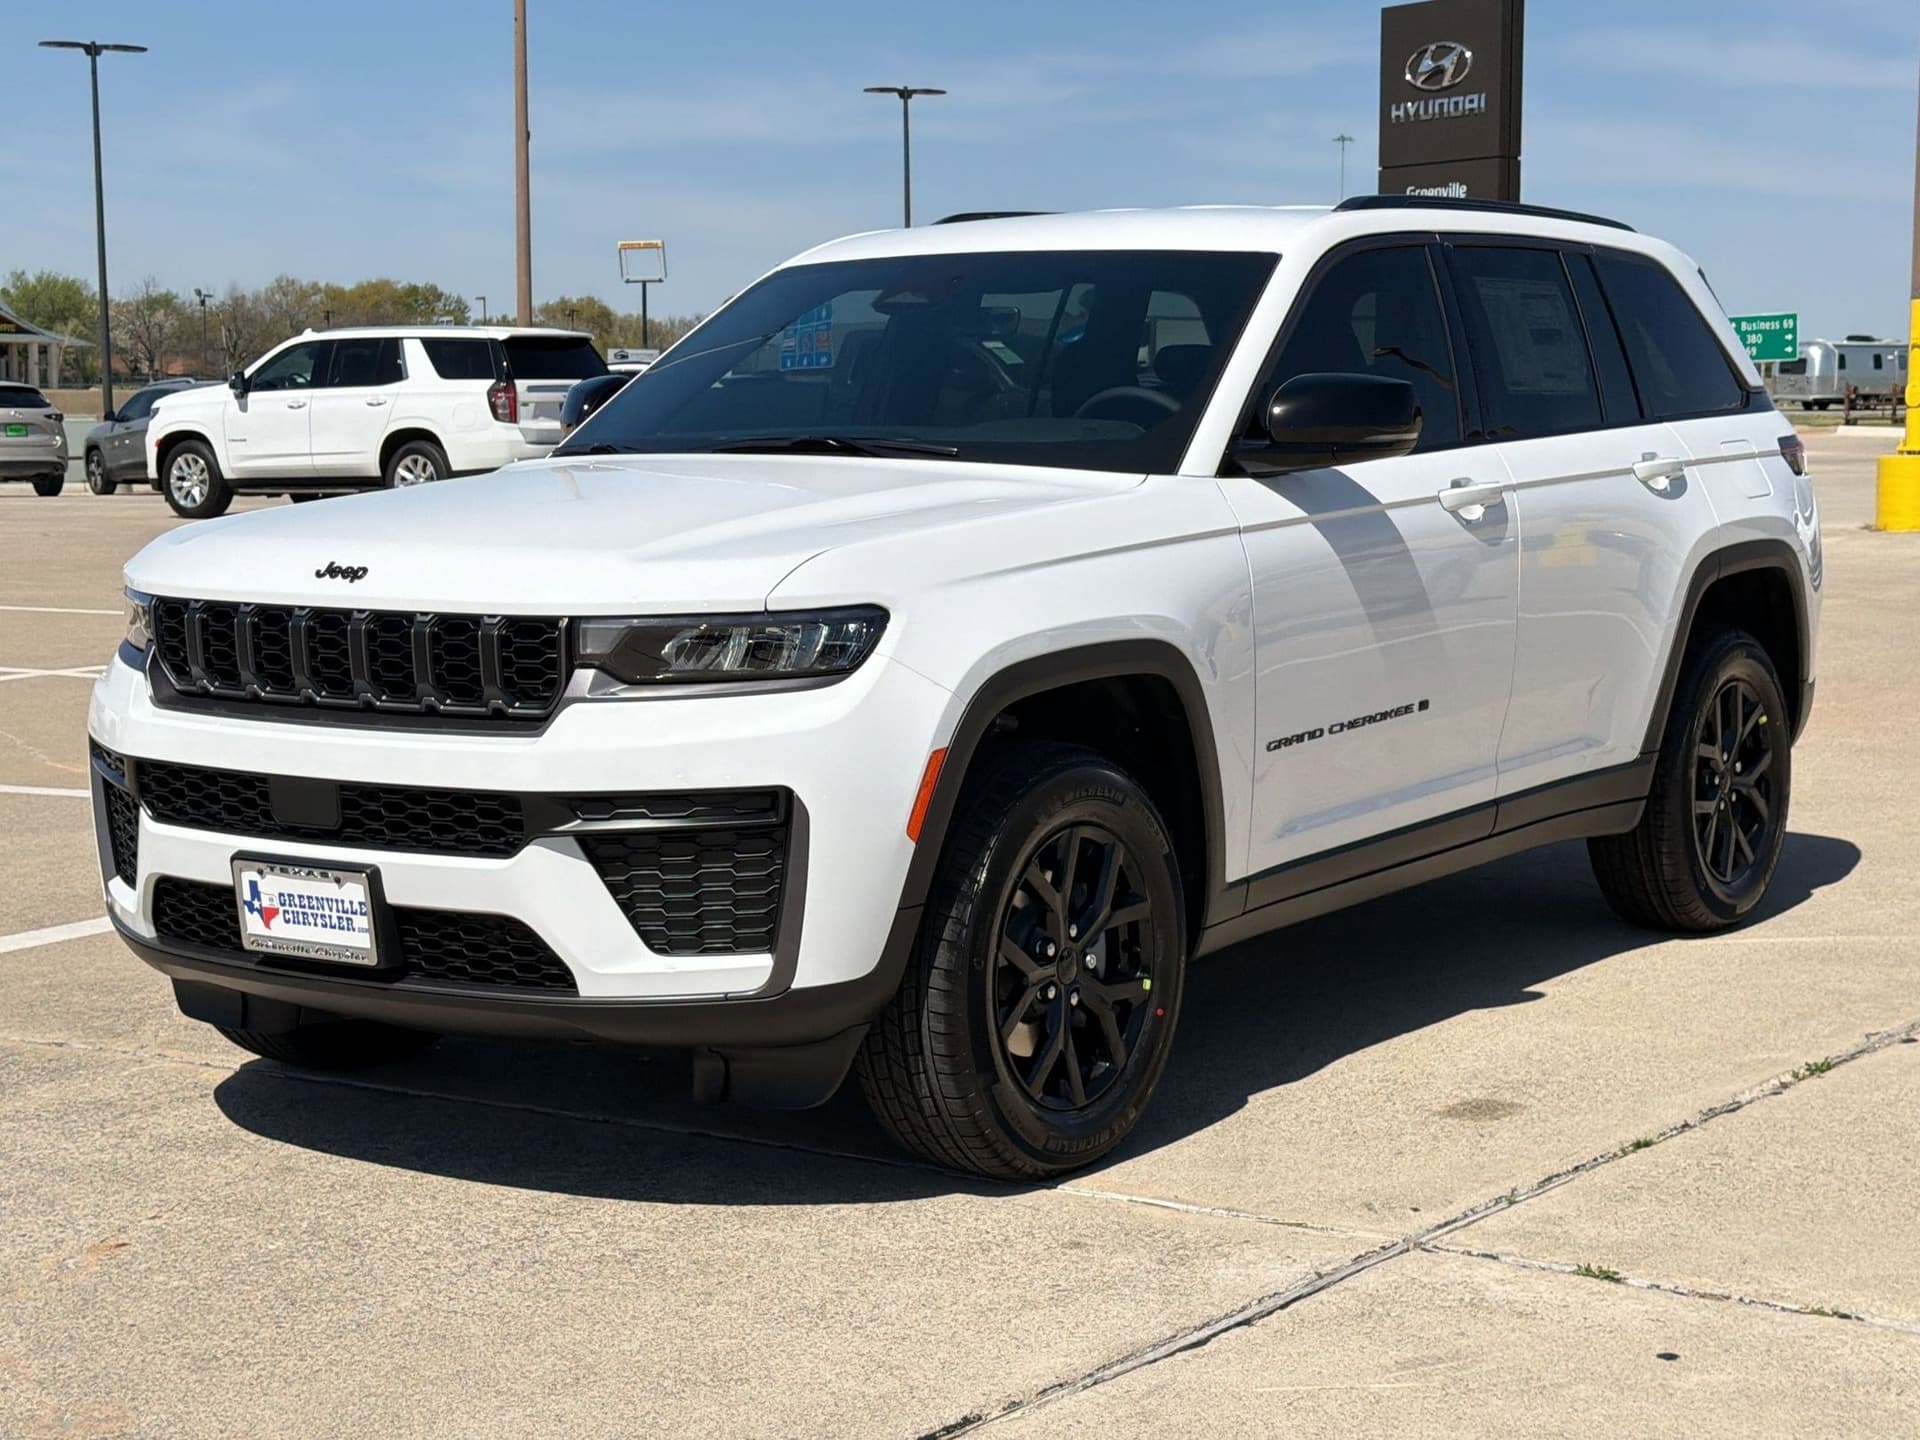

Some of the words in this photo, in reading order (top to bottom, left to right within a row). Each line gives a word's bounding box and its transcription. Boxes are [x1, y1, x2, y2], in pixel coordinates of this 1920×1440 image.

[1391, 93, 1487, 123] HYUNDAI
[1406, 180, 1468, 199] Greenville
[1741, 320, 1780, 331] Business
[1782, 318, 1794, 329] 69
[1746, 333, 1763, 344] 380
[315, 561, 369, 583] Jeep
[1266, 727, 1324, 752] GRAND
[1328, 703, 1415, 735] CHEROKEE
[266, 865, 331, 879] TEXAS
[278, 892, 368, 917] GREENVILLE
